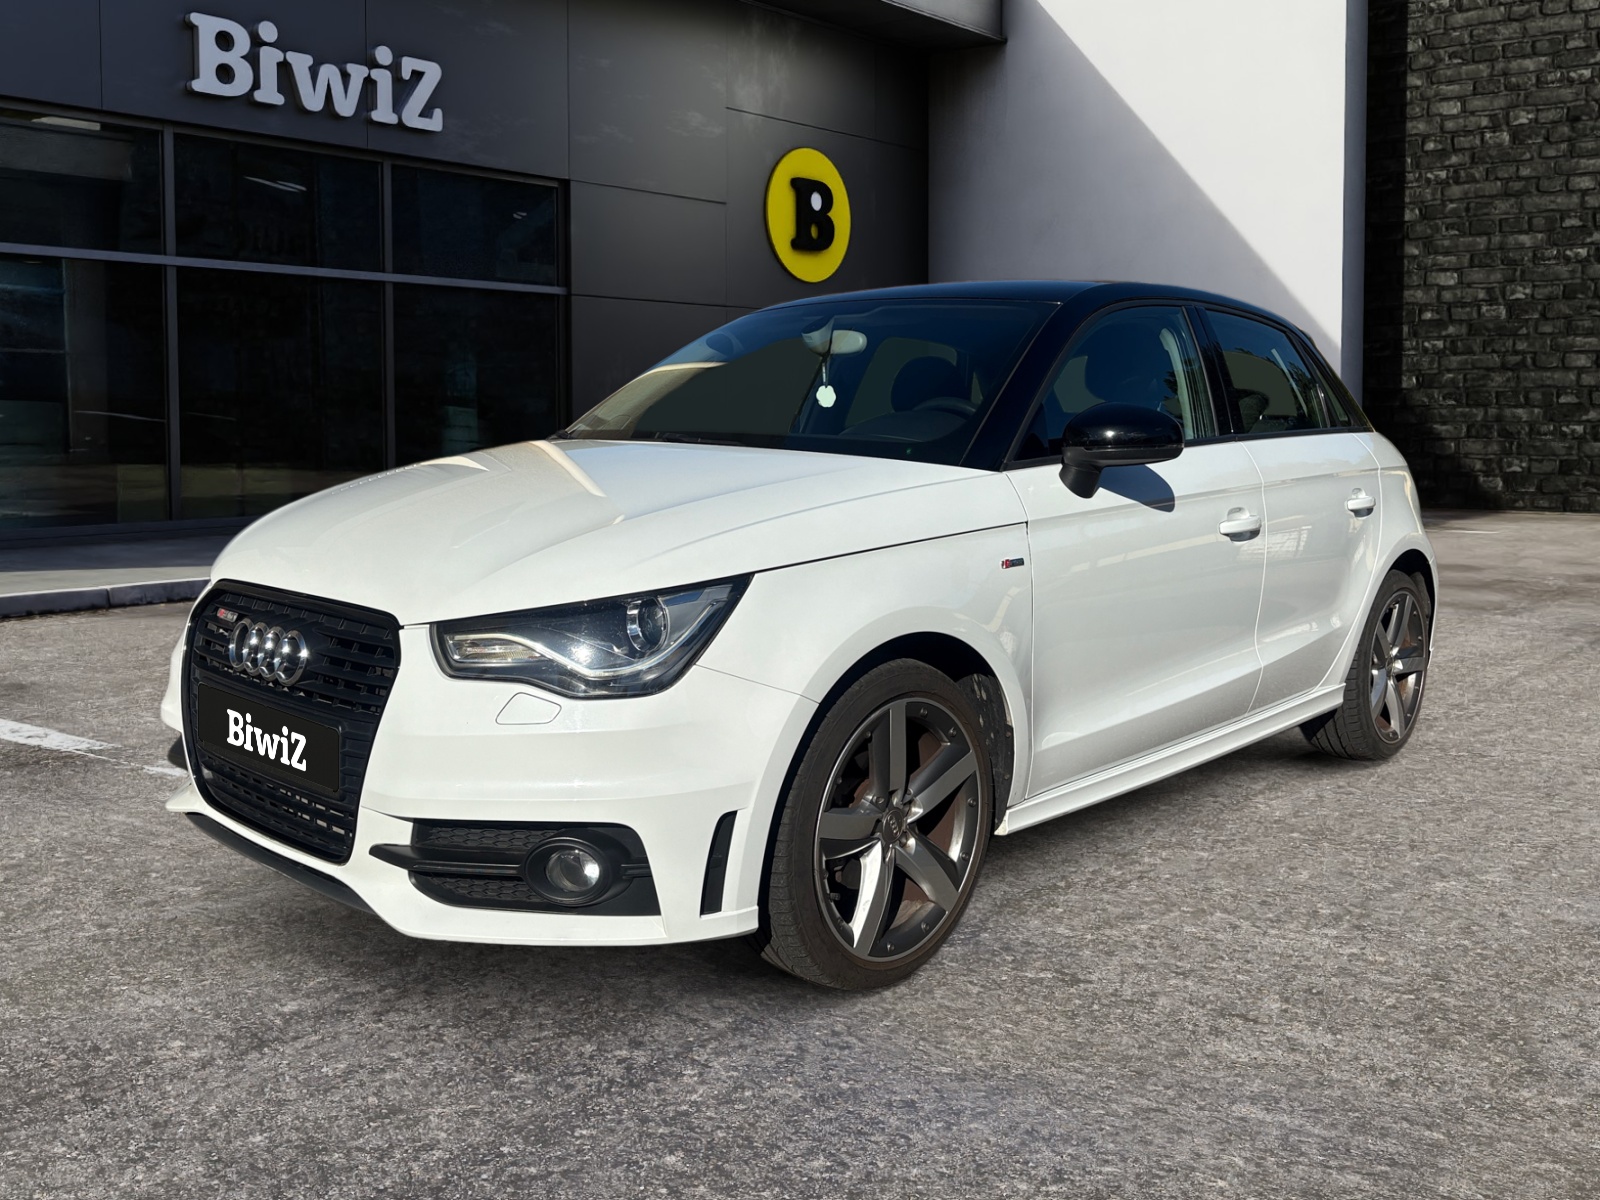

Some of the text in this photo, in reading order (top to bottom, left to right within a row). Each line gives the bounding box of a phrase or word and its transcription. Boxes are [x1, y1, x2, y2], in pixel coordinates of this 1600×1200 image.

[186, 12, 444, 132] BiwiZ
[790, 177, 836, 252] B
[226, 708, 307, 772] BiwiZ
